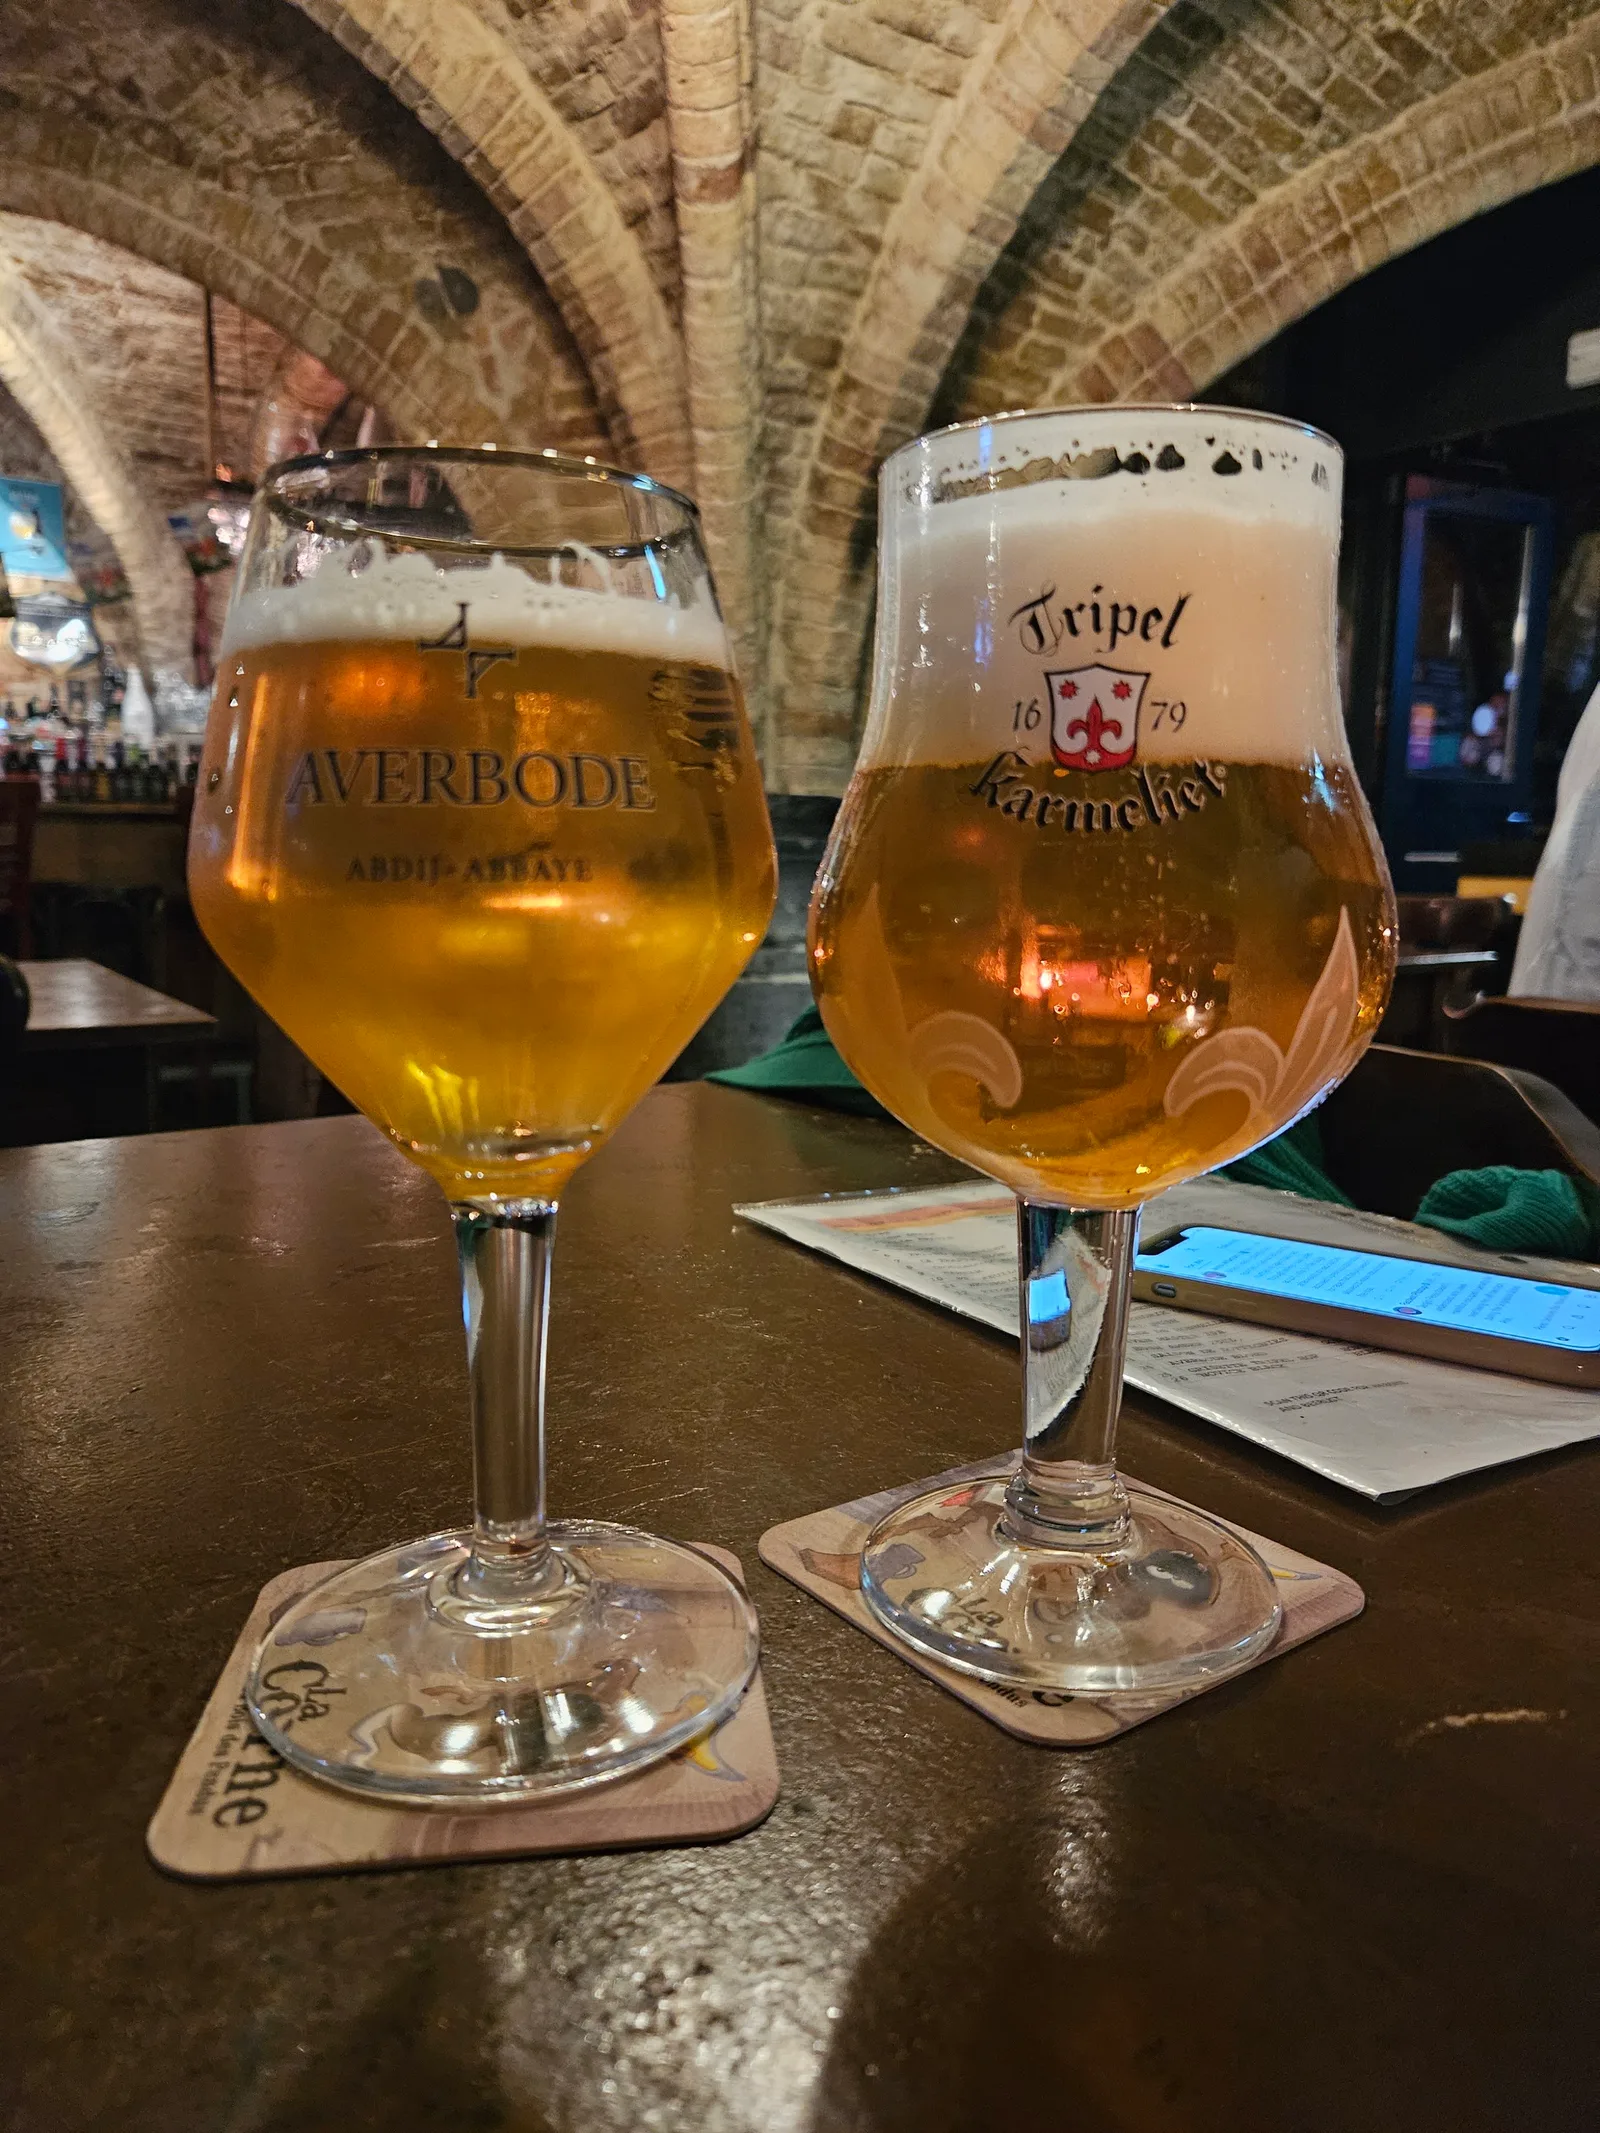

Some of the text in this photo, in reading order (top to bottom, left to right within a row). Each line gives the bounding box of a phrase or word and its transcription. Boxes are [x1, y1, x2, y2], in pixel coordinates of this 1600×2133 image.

[1007, 581, 1193, 656] Tripel
[1012, 699, 1188, 733] 16 79
[285, 748, 656, 811] AVERBODE
[968, 750, 1226, 833] Karmeliet
